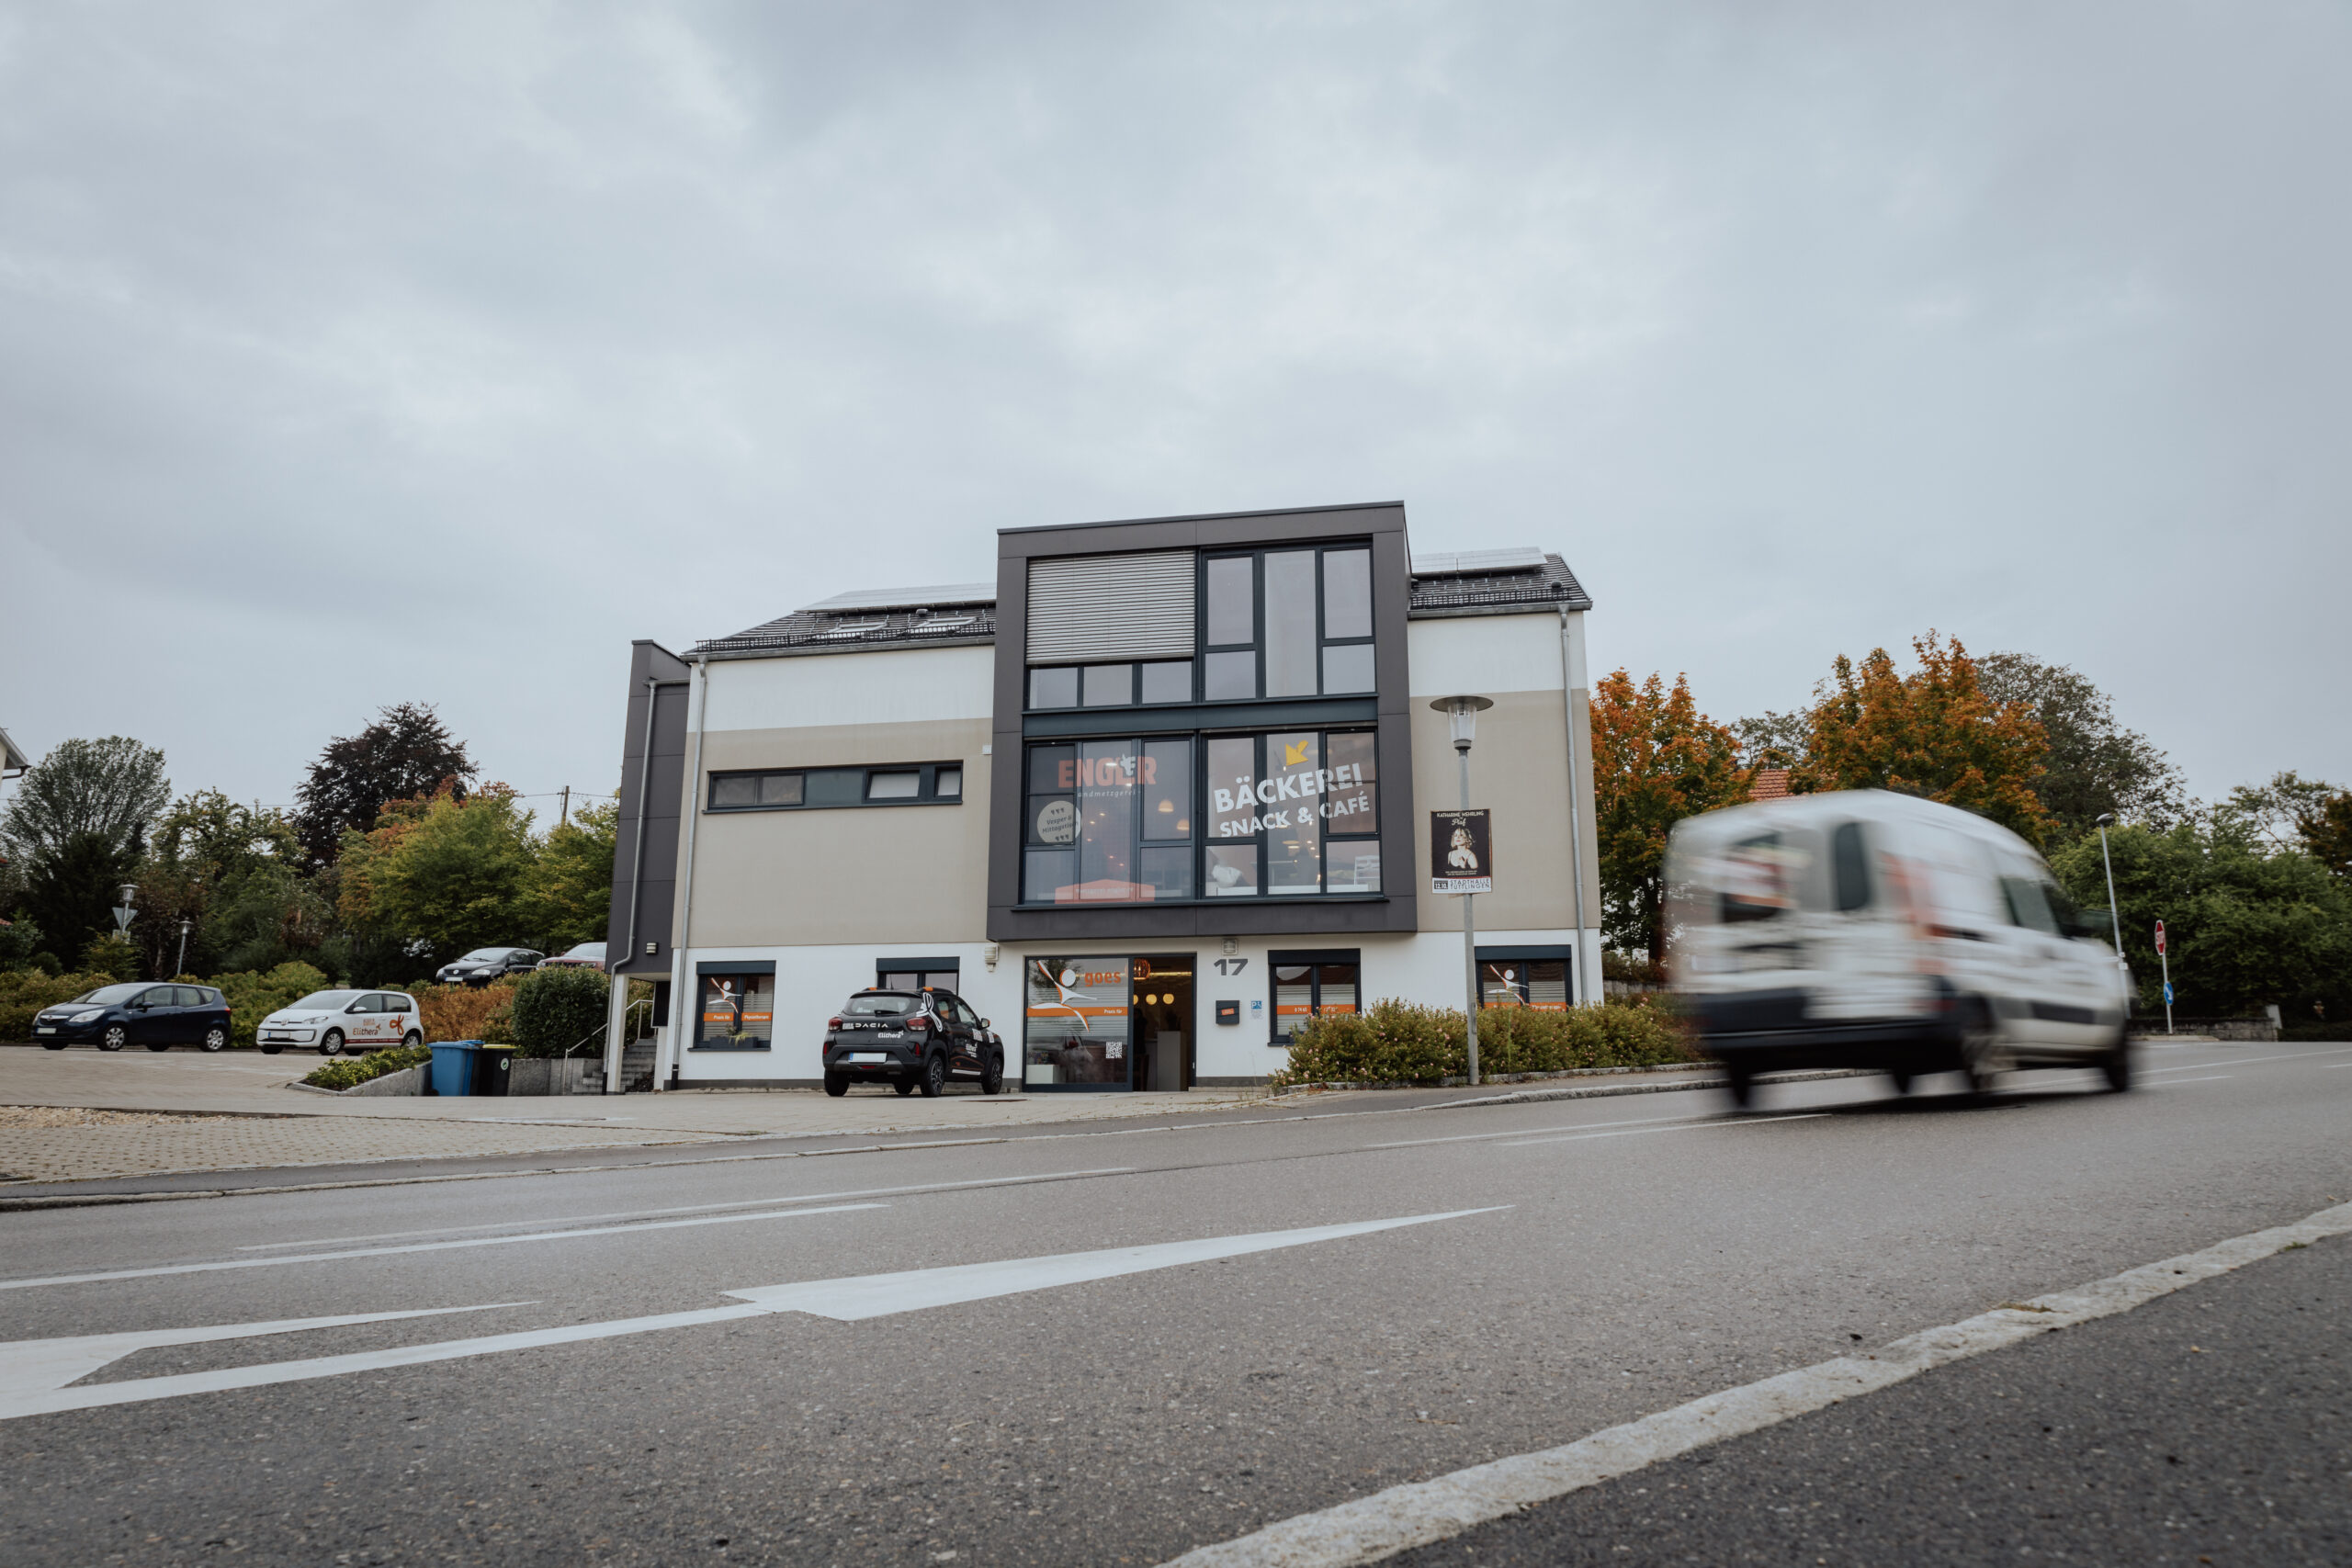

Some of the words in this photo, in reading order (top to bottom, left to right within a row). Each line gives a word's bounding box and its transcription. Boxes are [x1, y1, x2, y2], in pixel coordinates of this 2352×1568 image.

[1214, 762, 1363, 813] BÄCKEREI
[1219, 810, 1292, 838] SNACK
[1297, 807, 1314, 824] &
[1319, 791, 1370, 818] CAFÉ
[1043, 821, 1079, 833] Mittagstish
[1214, 958, 1249, 976] 17
[1084, 971, 1122, 987] goes
[353, 1027, 378, 1035] Elithera
